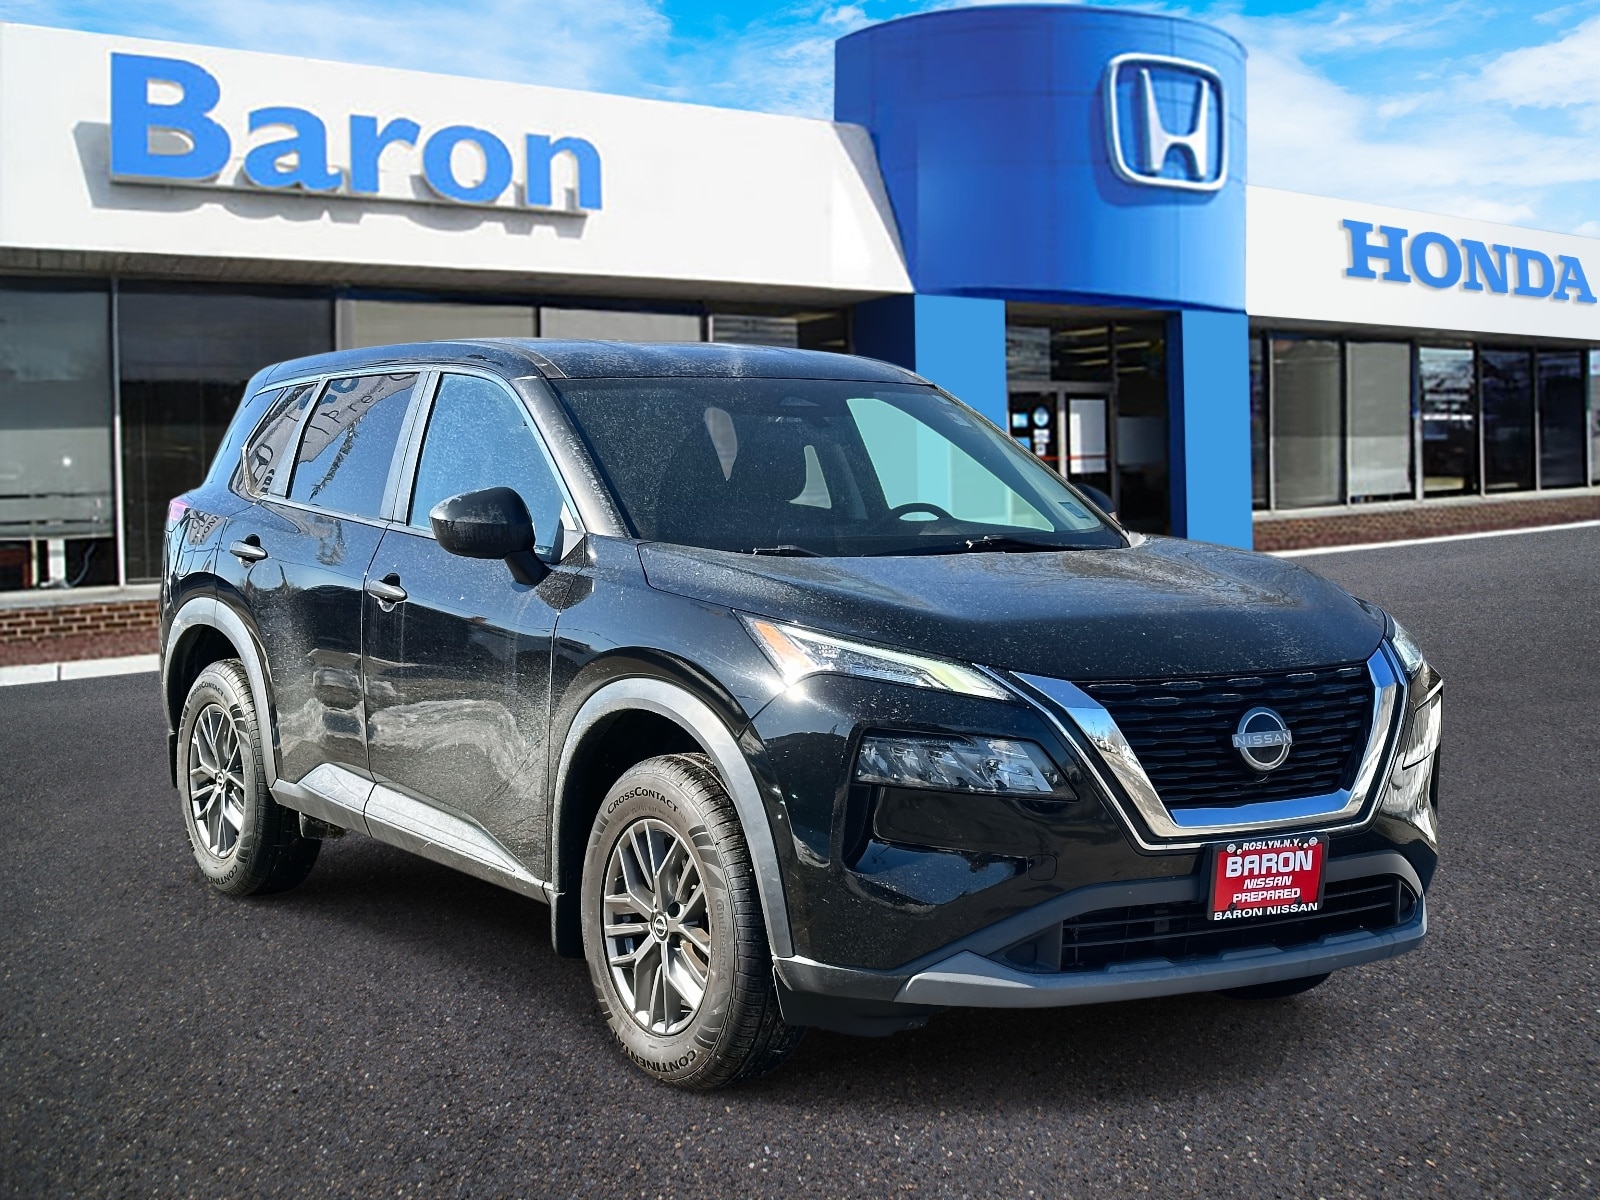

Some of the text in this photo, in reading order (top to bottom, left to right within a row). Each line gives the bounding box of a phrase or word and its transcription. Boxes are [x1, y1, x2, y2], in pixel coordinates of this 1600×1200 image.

[110, 52, 602, 210] Baron
[1342, 218, 1598, 304] HONDA
[1234, 732, 1291, 746] NISSAN
[1225, 850, 1313, 878] BARON
[1243, 875, 1293, 890] NISSAN
[1232, 887, 1301, 904] PREPARED
[1213, 902, 1318, 921] BARON NISSAN
